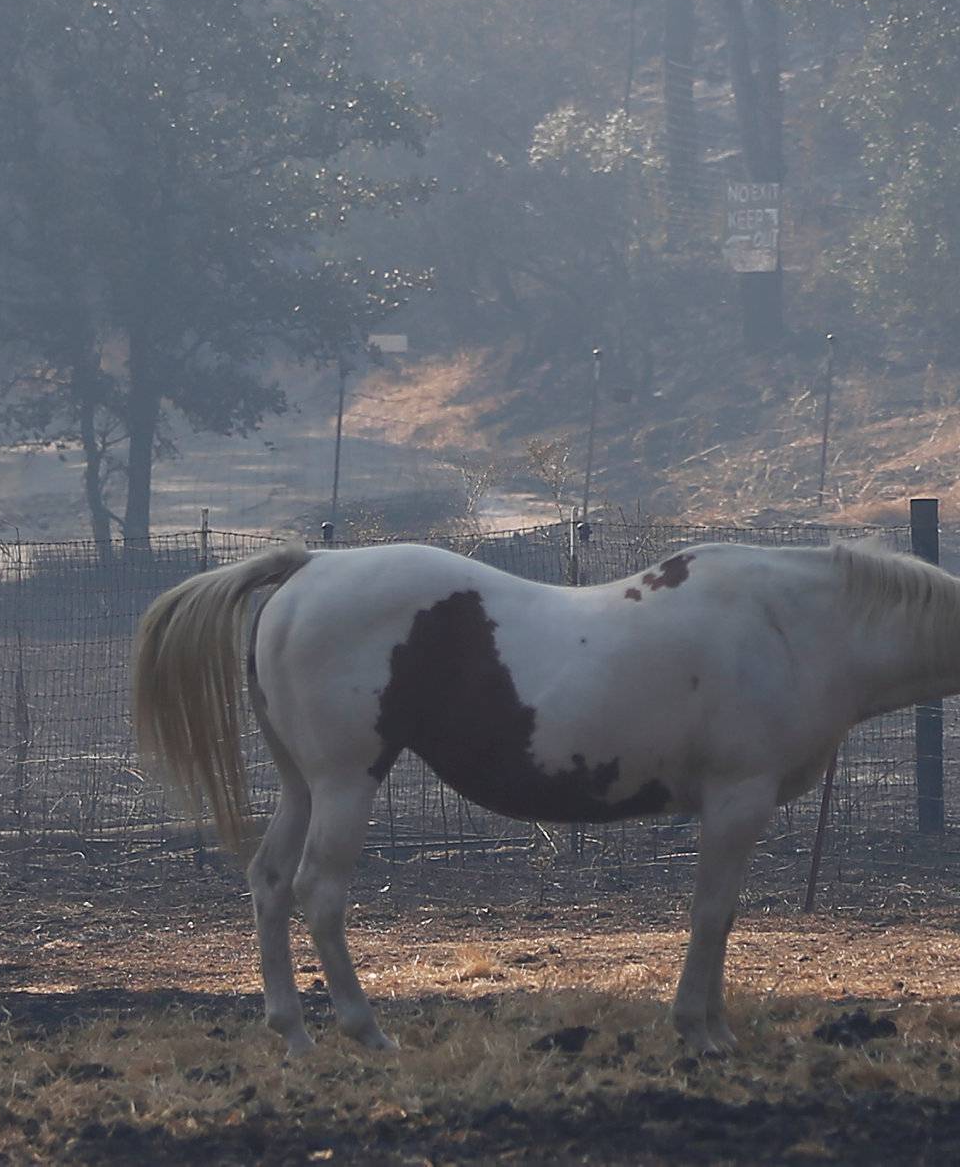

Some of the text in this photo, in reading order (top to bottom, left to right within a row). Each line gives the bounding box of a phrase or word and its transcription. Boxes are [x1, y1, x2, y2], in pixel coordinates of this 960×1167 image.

[727, 184, 749, 202] NO
[727, 208, 764, 229] KEEP
[753, 229, 779, 247] OUT
